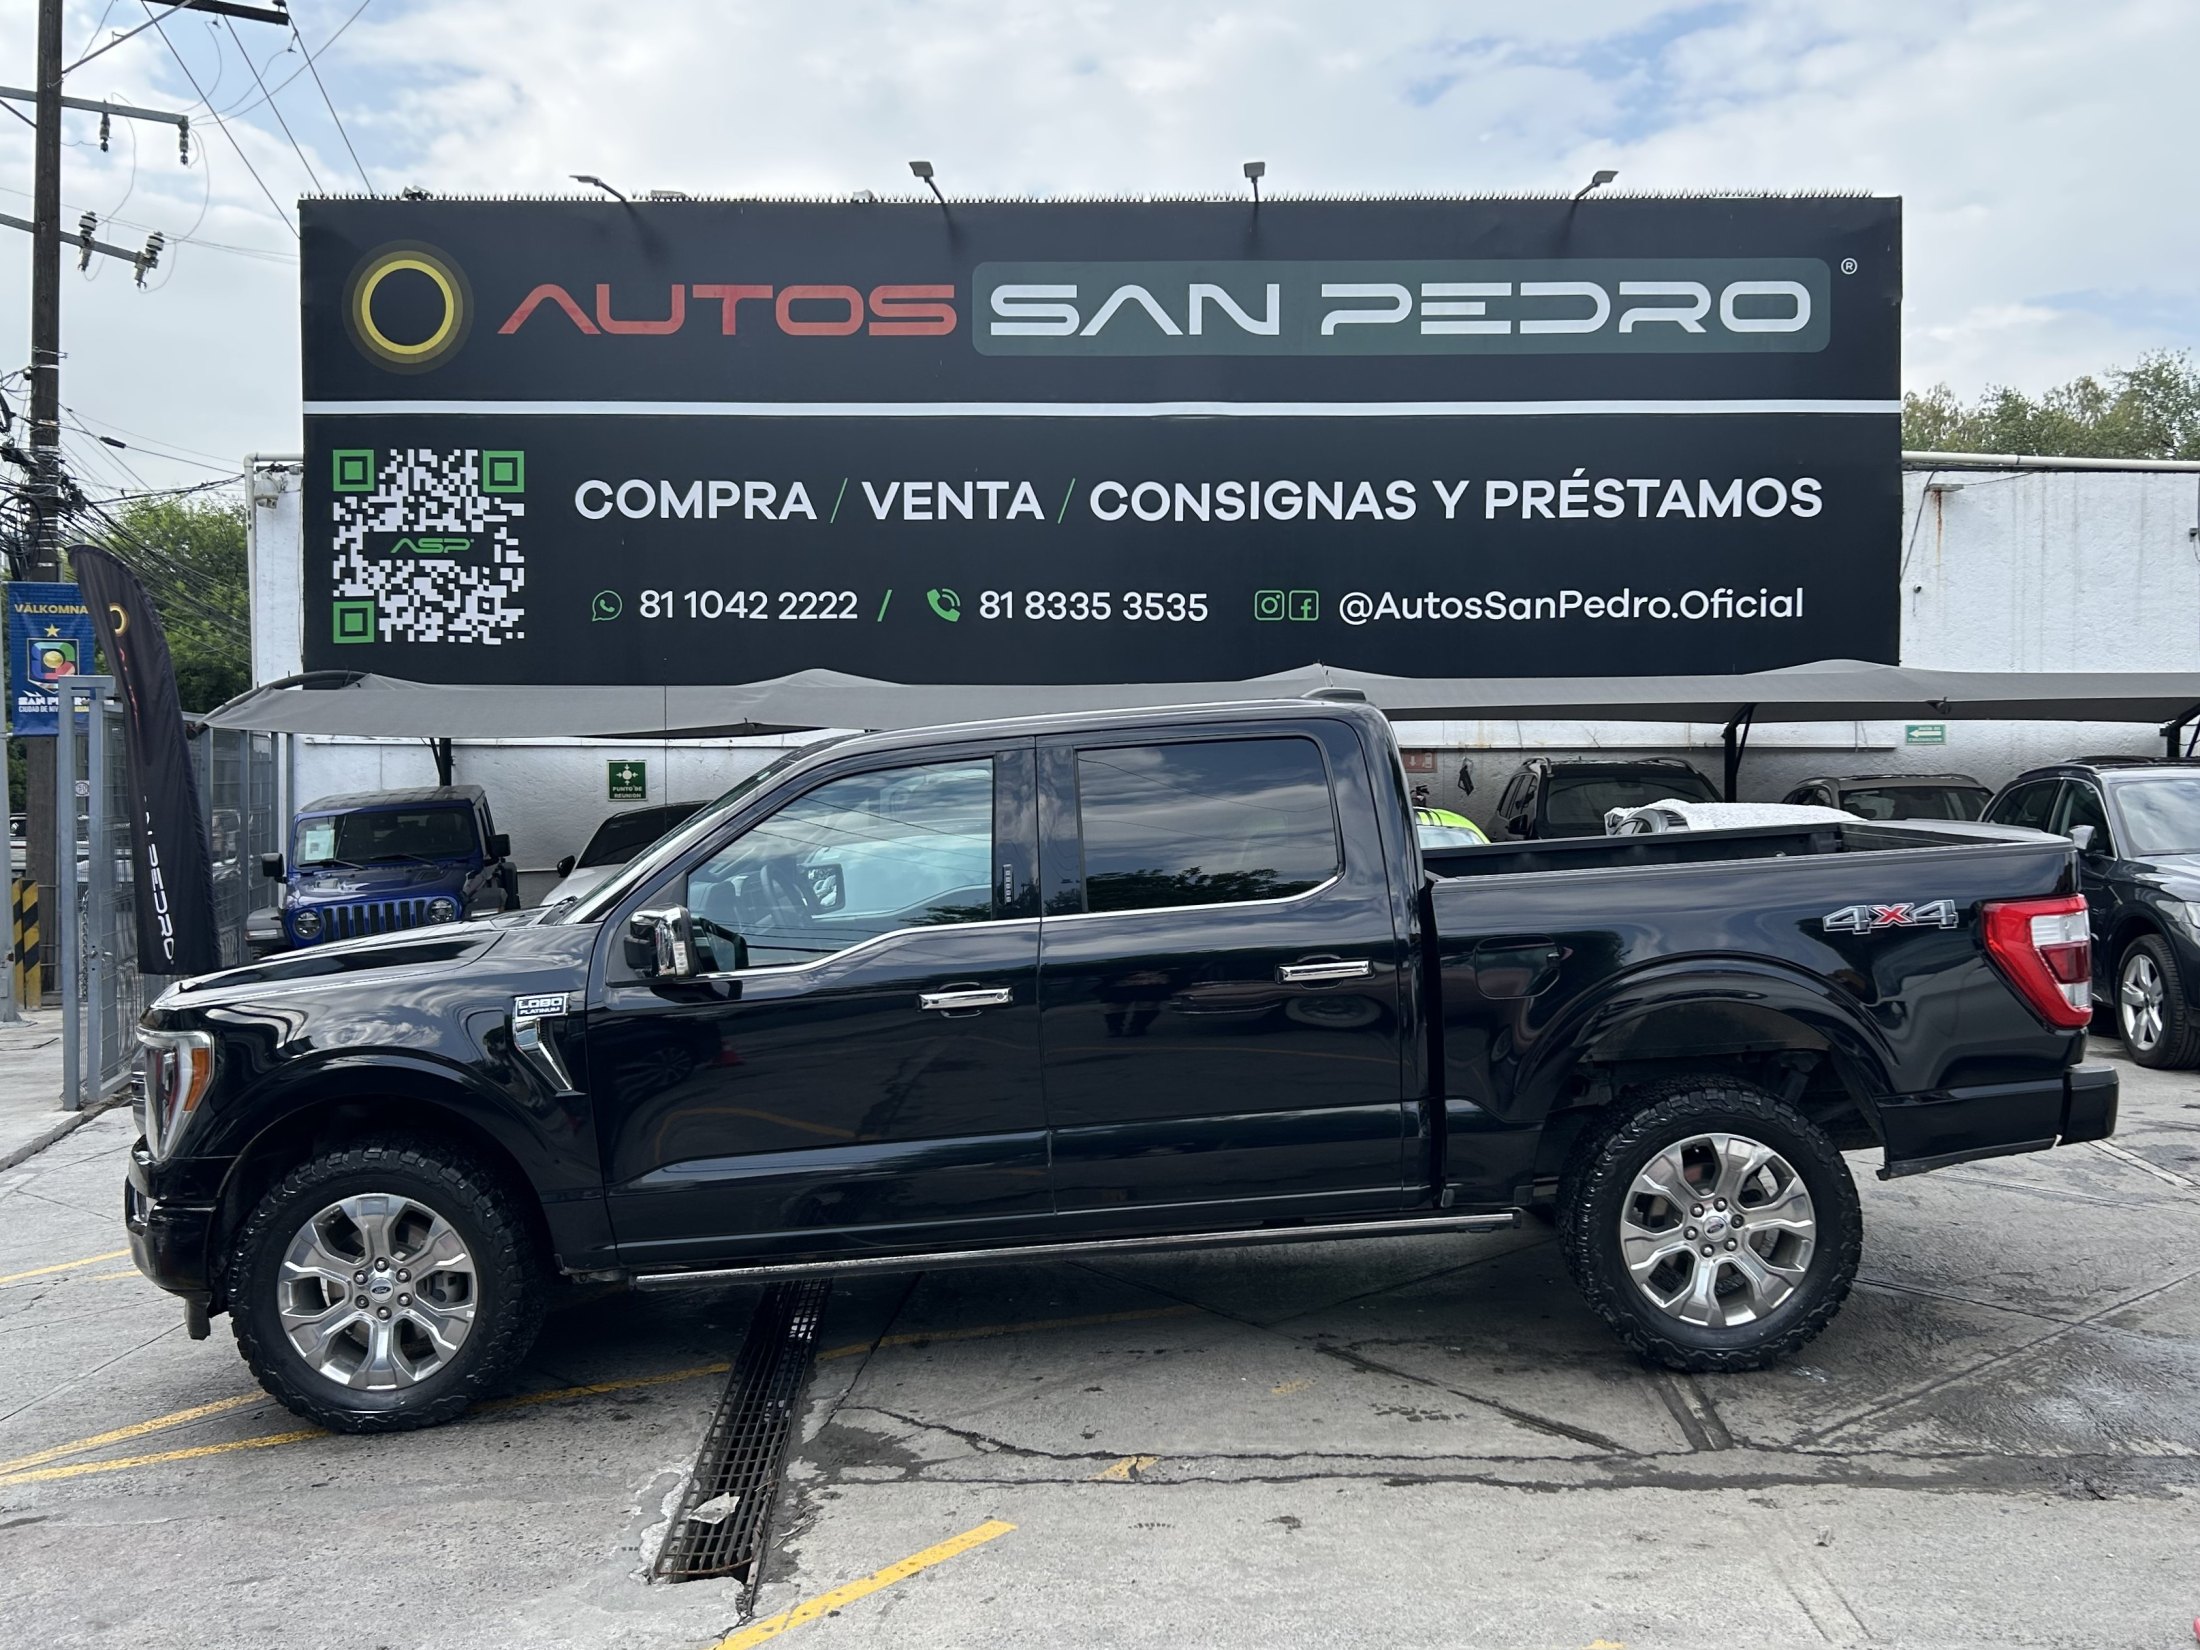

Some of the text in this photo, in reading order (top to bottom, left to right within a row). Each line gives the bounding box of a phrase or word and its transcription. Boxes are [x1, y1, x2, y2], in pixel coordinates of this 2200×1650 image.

[497, 283, 957, 336] AUTOS
[990, 283, 1280, 337] SAN
[1320, 280, 1812, 336] PEDRO
[574, 479, 818, 521] COMPRA
[861, 480, 1045, 521] VENTA
[1089, 479, 1418, 523] CONSIGNAS
[1432, 480, 1469, 519] Y
[1485, 467, 1824, 520] PRÉSTAMOS
[390, 537, 471, 554] ASP
[14, 602, 89, 614] VÄLKOMNA
[639, 590, 673, 619] 81
[684, 590, 768, 620] 1042
[778, 590, 858, 620] 2222
[979, 590, 1209, 622] 81 8335 3535
[1339, 587, 1804, 627] @AutosSanPedro.Oficial
[518, 997, 563, 1010] LOBO
[519, 1006, 561, 1016] PLATINUM
